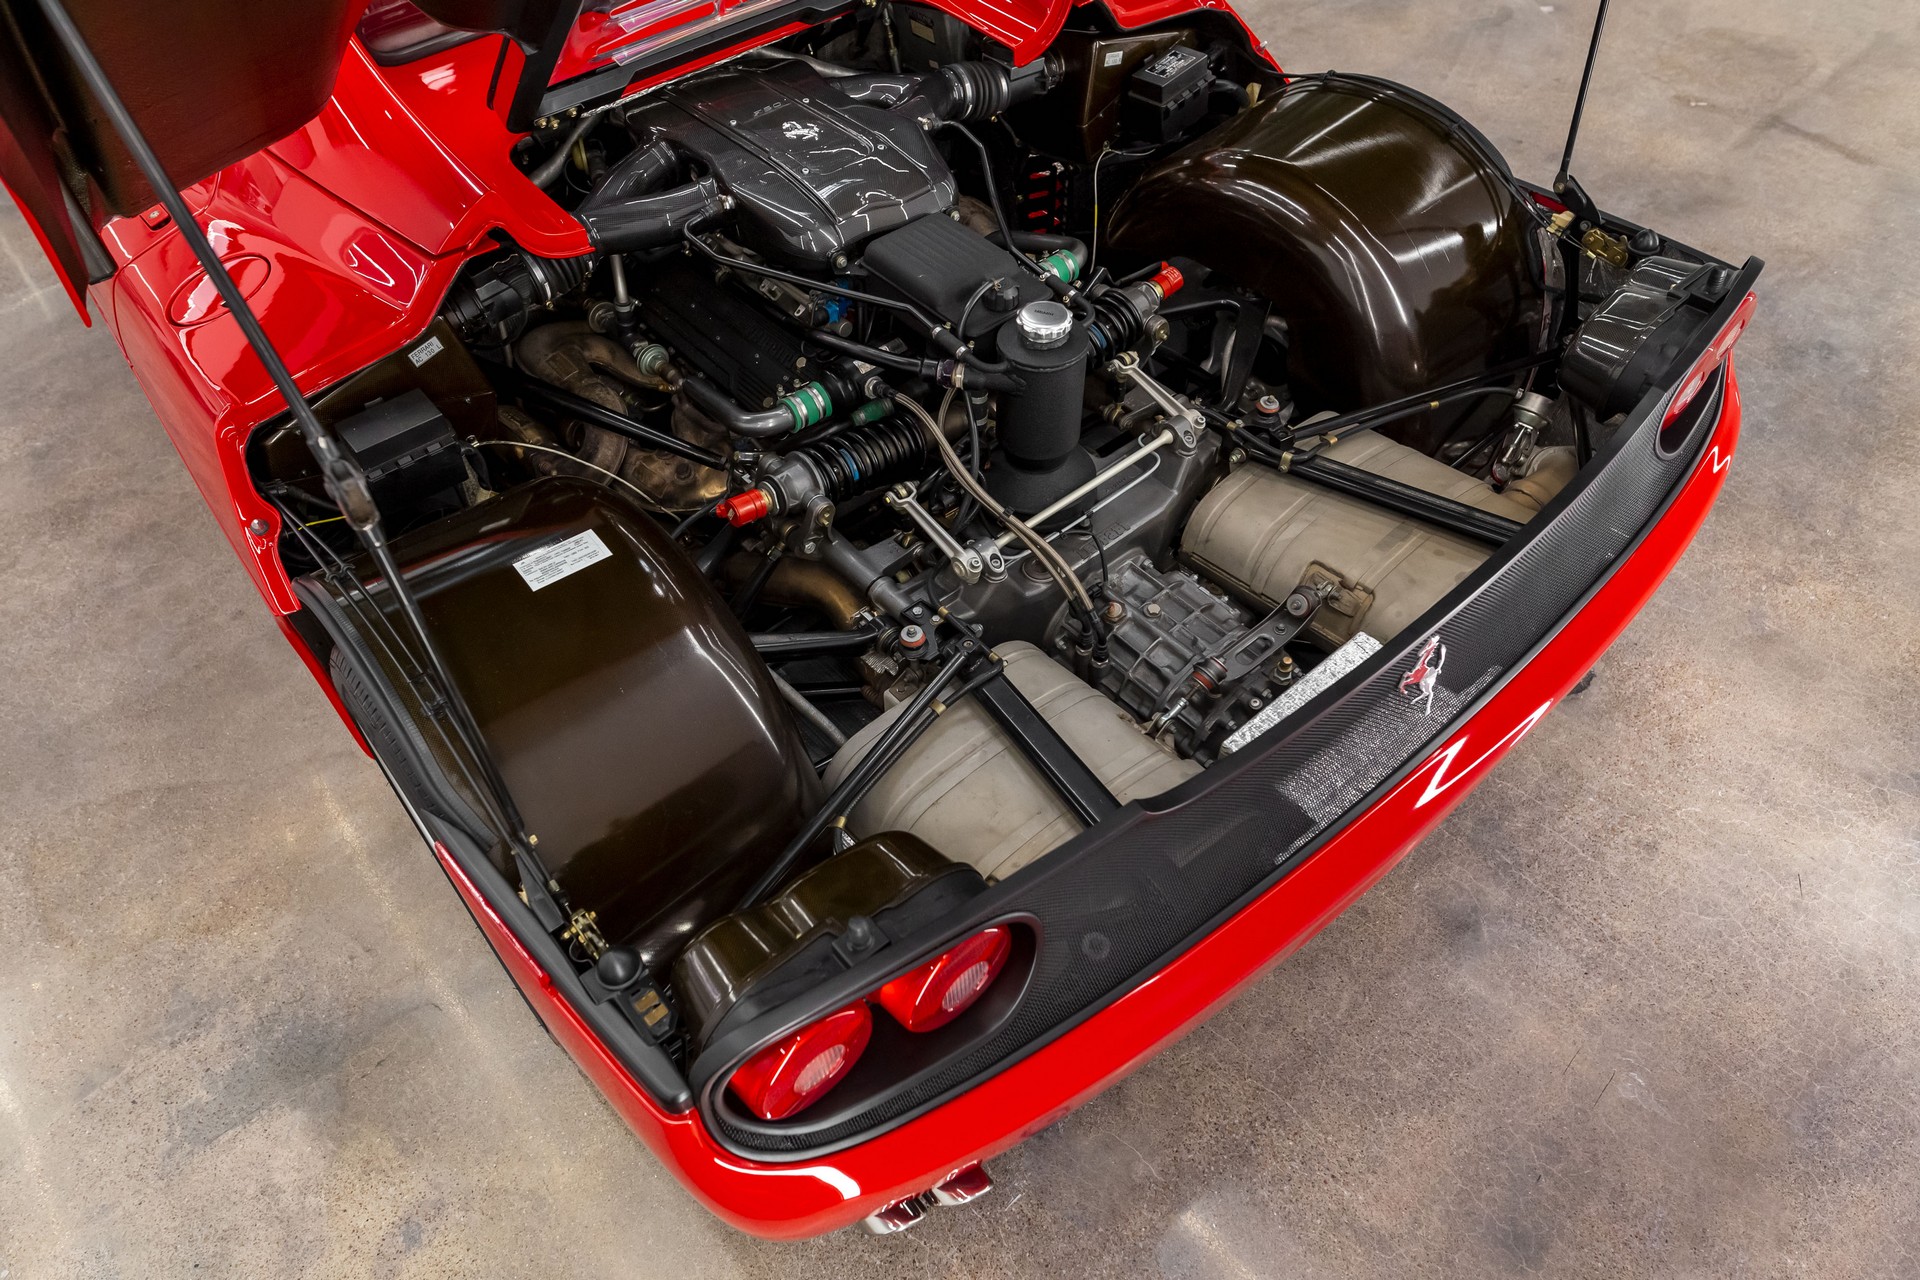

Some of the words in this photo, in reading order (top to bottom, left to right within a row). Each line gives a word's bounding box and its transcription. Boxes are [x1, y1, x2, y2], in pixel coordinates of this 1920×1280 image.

[411, 341, 434, 360] FERRARI
[415, 356, 424, 365] AC
[425, 348, 435, 357] 130
